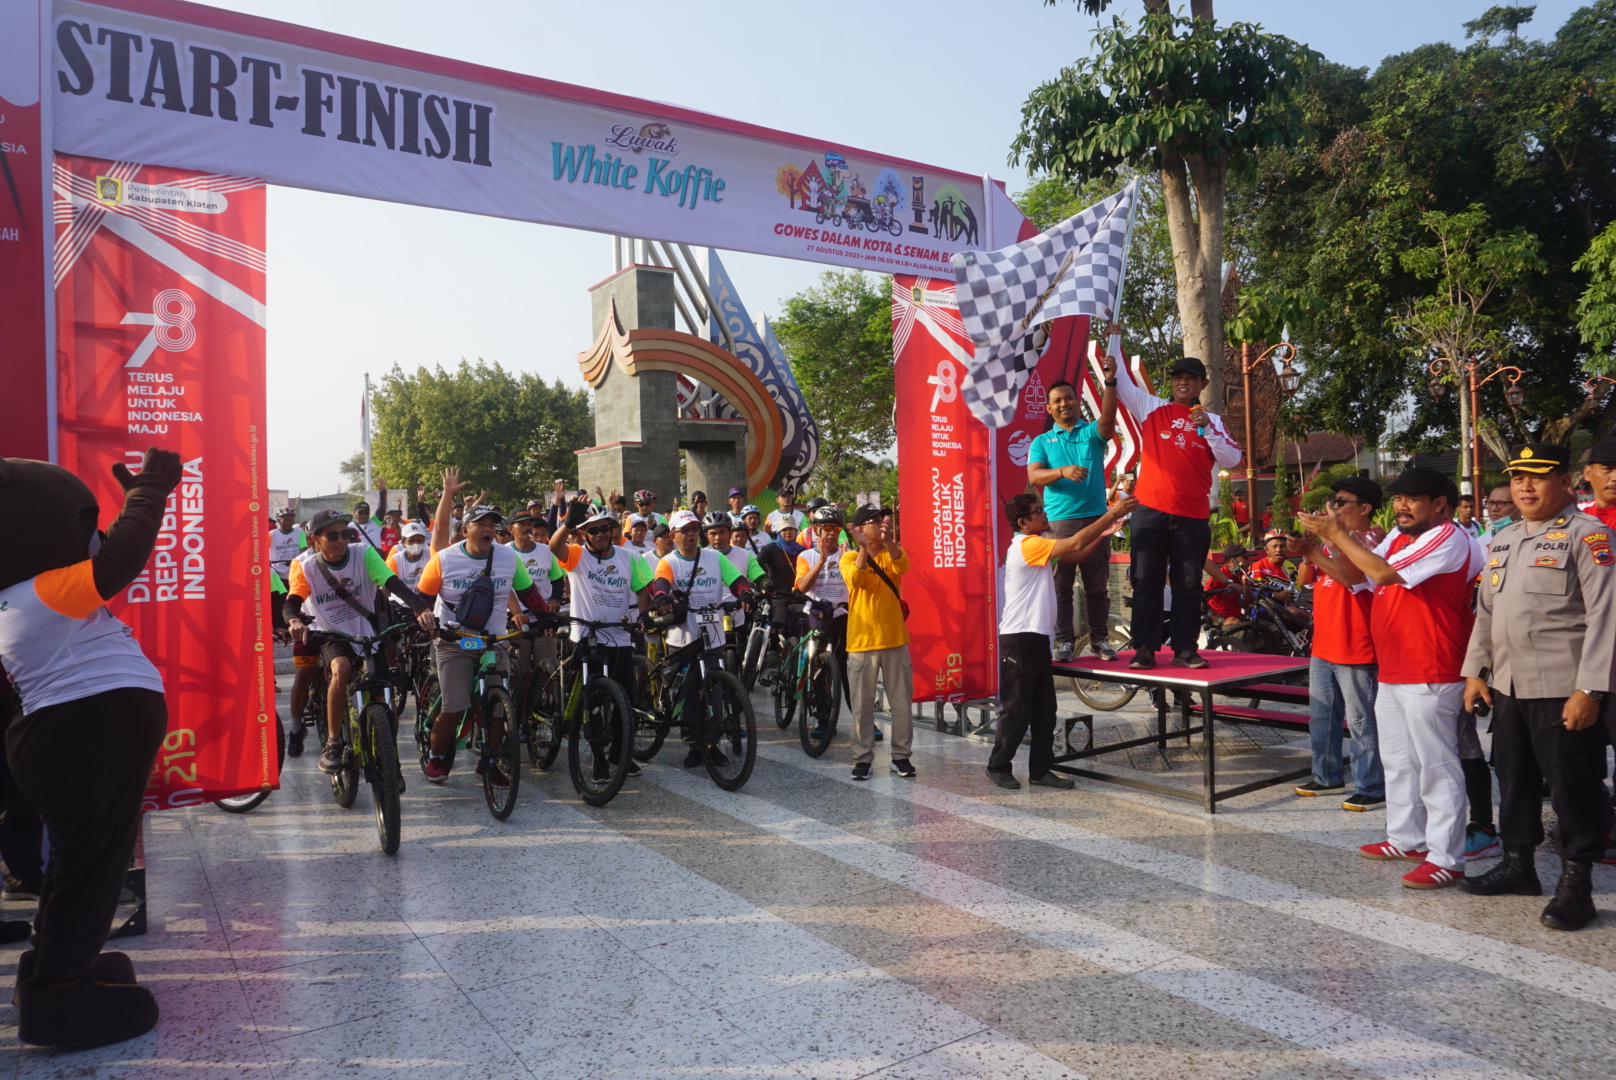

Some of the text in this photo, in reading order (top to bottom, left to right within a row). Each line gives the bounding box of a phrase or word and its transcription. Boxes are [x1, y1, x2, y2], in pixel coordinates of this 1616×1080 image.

[56, 19, 494, 168] START-FINISH
[605, 125, 678, 154] Luwak
[551, 142, 726, 210] White Koffie
[128, 184, 186, 198] Pemerintah
[128, 193, 218, 210] Kabupaten Klaten
[774, 223, 820, 241] GOWES
[821, 231, 861, 249] DALAM
[863, 238, 893, 252] KOTA
[894, 244, 902, 256] &
[904, 245, 939, 262] SENAM
[816, 245, 844, 257] AGUSTUS
[845, 251, 860, 259] 2023
[877, 256, 894, 265] 06.00
[912, 263, 943, 273] ALUN-ALUN
[119, 288, 197, 368] 78
[127, 372, 174, 383] TERUS
[127, 385, 185, 396] MELAJU
[127, 398, 177, 409] UNTUK
[127, 411, 203, 422] INDONESIA
[931, 415, 948, 423] TERUS
[127, 424, 168, 434] MAJU
[932, 432, 950, 440] UNTUK
[932, 441, 963, 449] INDONESIA
[181, 457, 206, 600] INDONESIA
[931, 467, 943, 568] DIRGAHAYU
[941, 483, 954, 568] REPUBLIK
[952, 473, 967, 568] INDONESIA
[252, 539, 260, 562] Humas
[1535, 542, 1570, 551] POLRI
[255, 617, 263, 641] Humas
[702, 614, 715, 622] 123
[464, 641, 478, 649] 03
[946, 652, 963, 689] 219
[257, 656, 266, 712] humaskabklaten
[163, 728, 197, 786] 219
[261, 727, 269, 781] humaskabklaten
